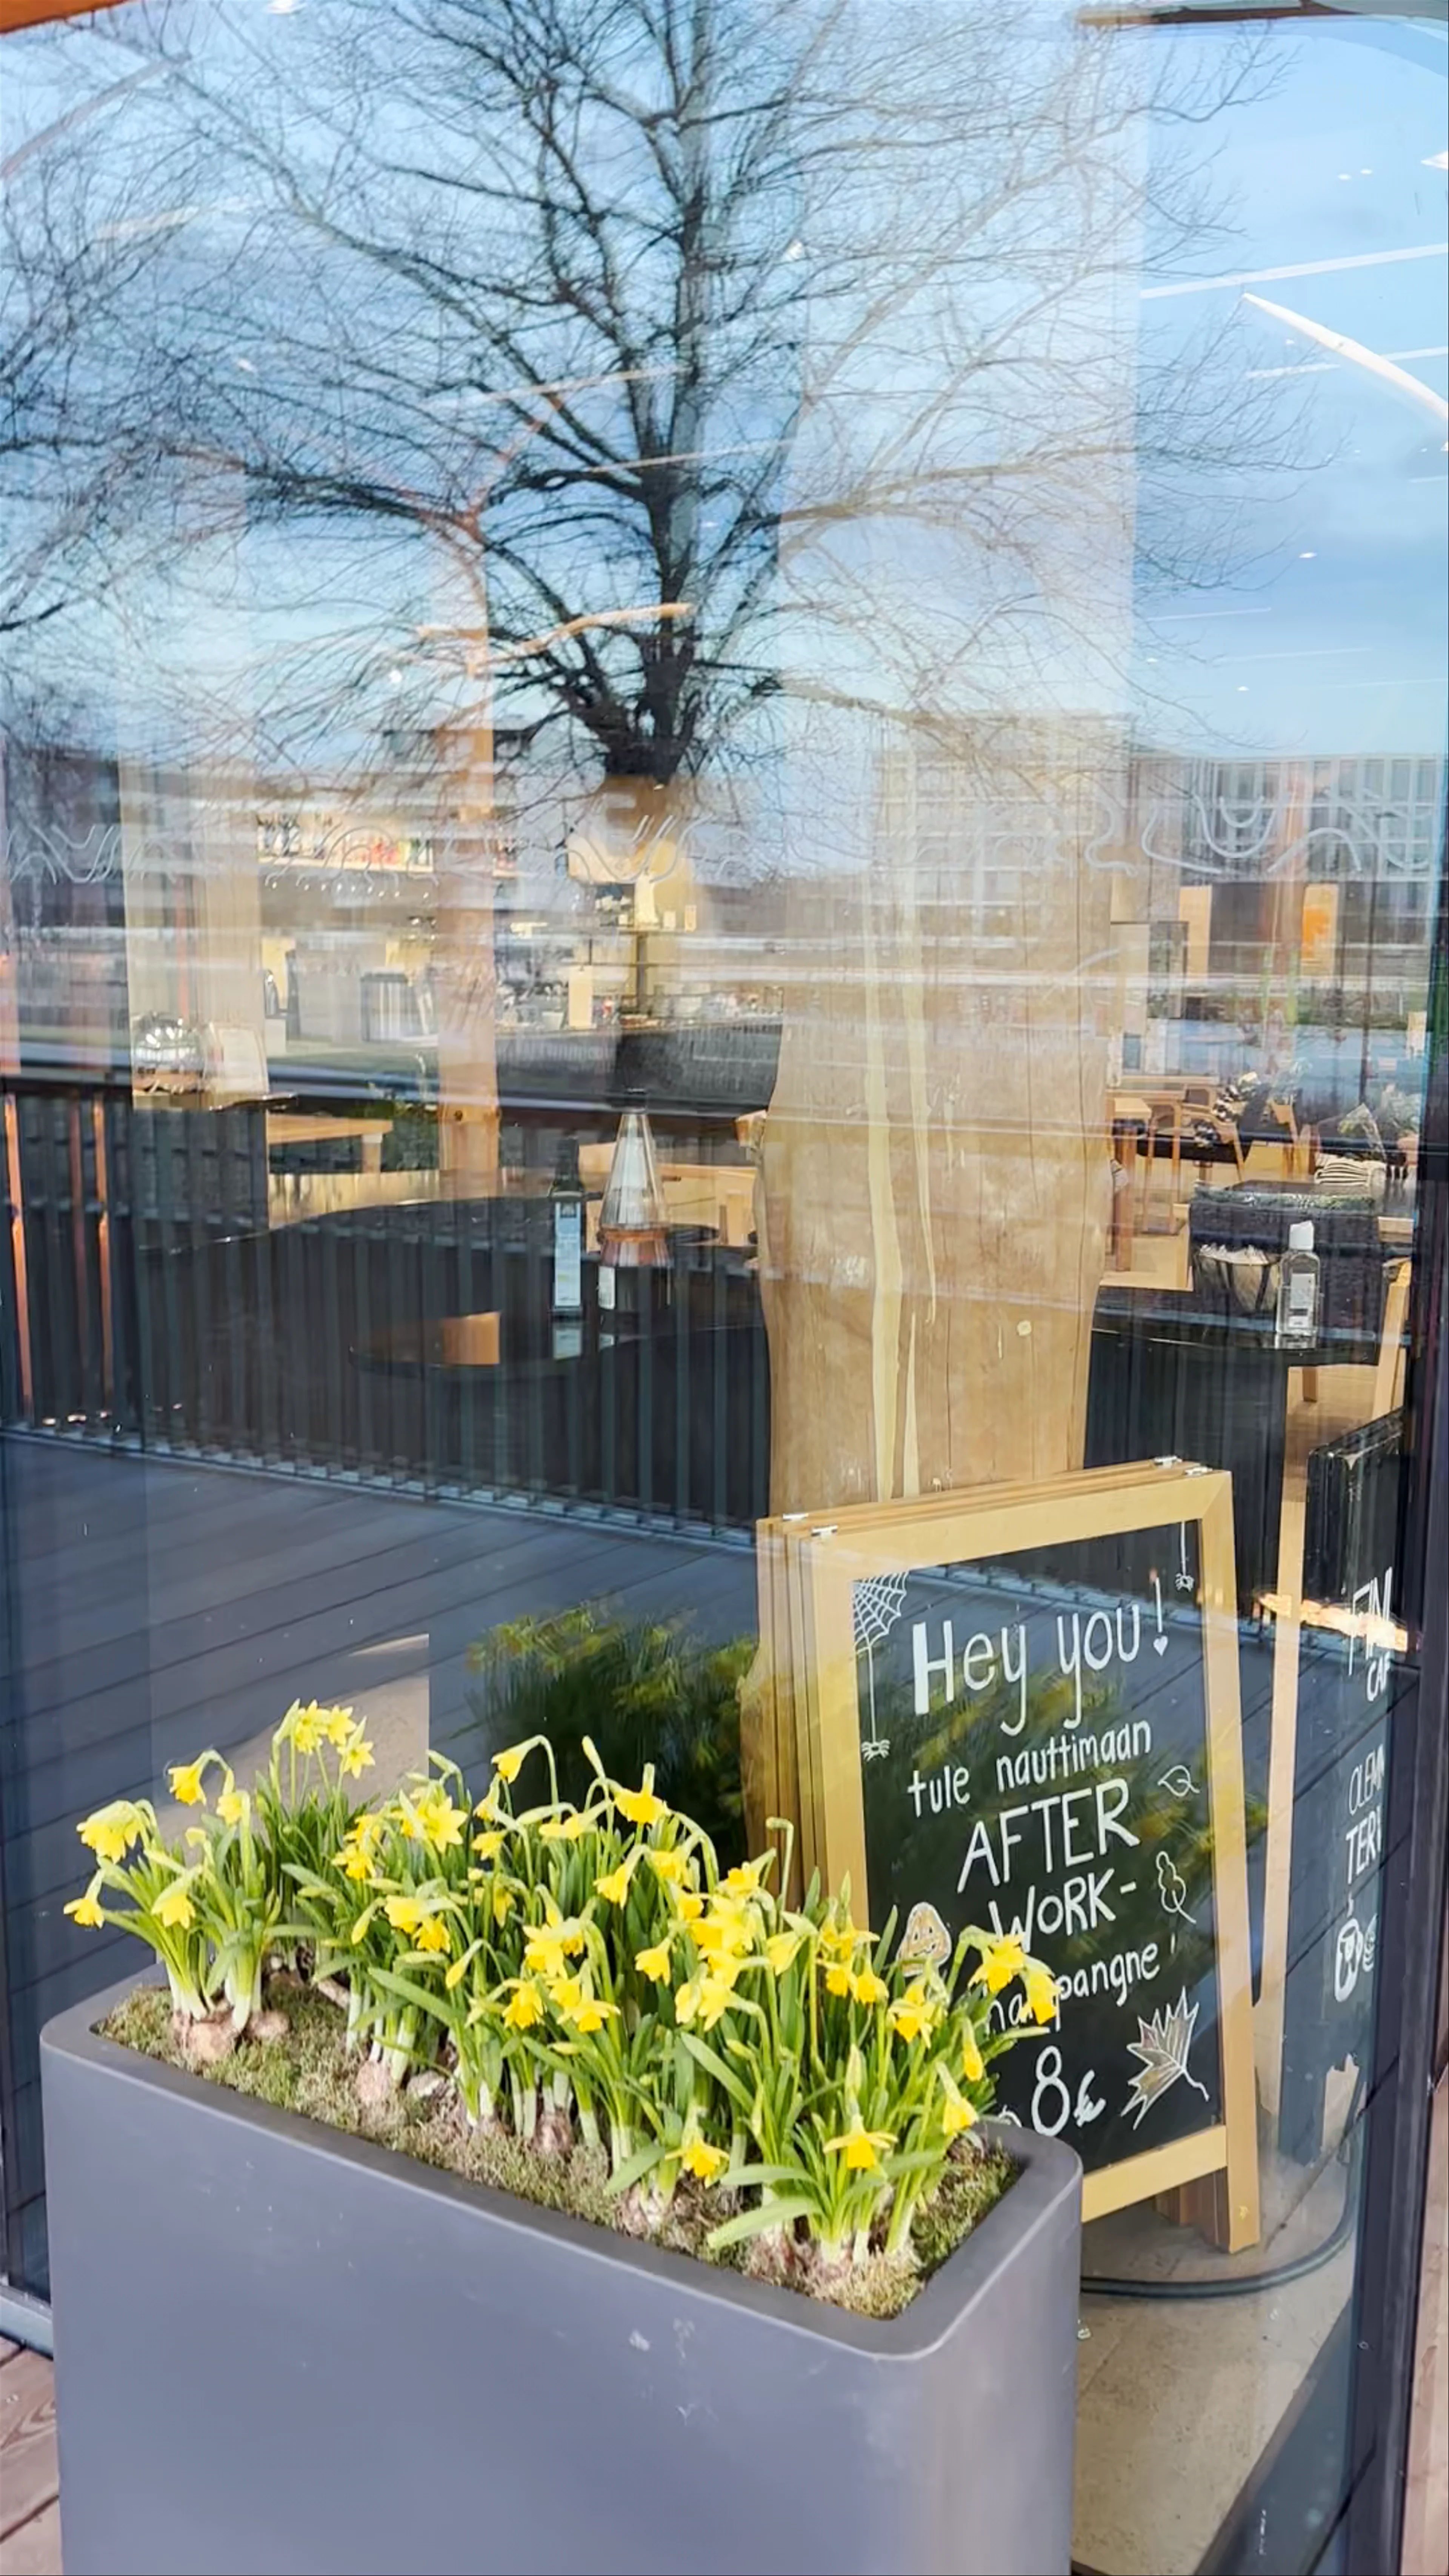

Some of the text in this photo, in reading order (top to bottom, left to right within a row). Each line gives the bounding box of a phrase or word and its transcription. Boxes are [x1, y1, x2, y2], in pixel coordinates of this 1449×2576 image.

[912, 1576, 1168, 1736] Hey you!
[907, 1719, 1151, 1818] tule nauttimaan
[957, 1777, 1140, 1893] AFTER
[988, 1868, 1137, 1954] WORK-
